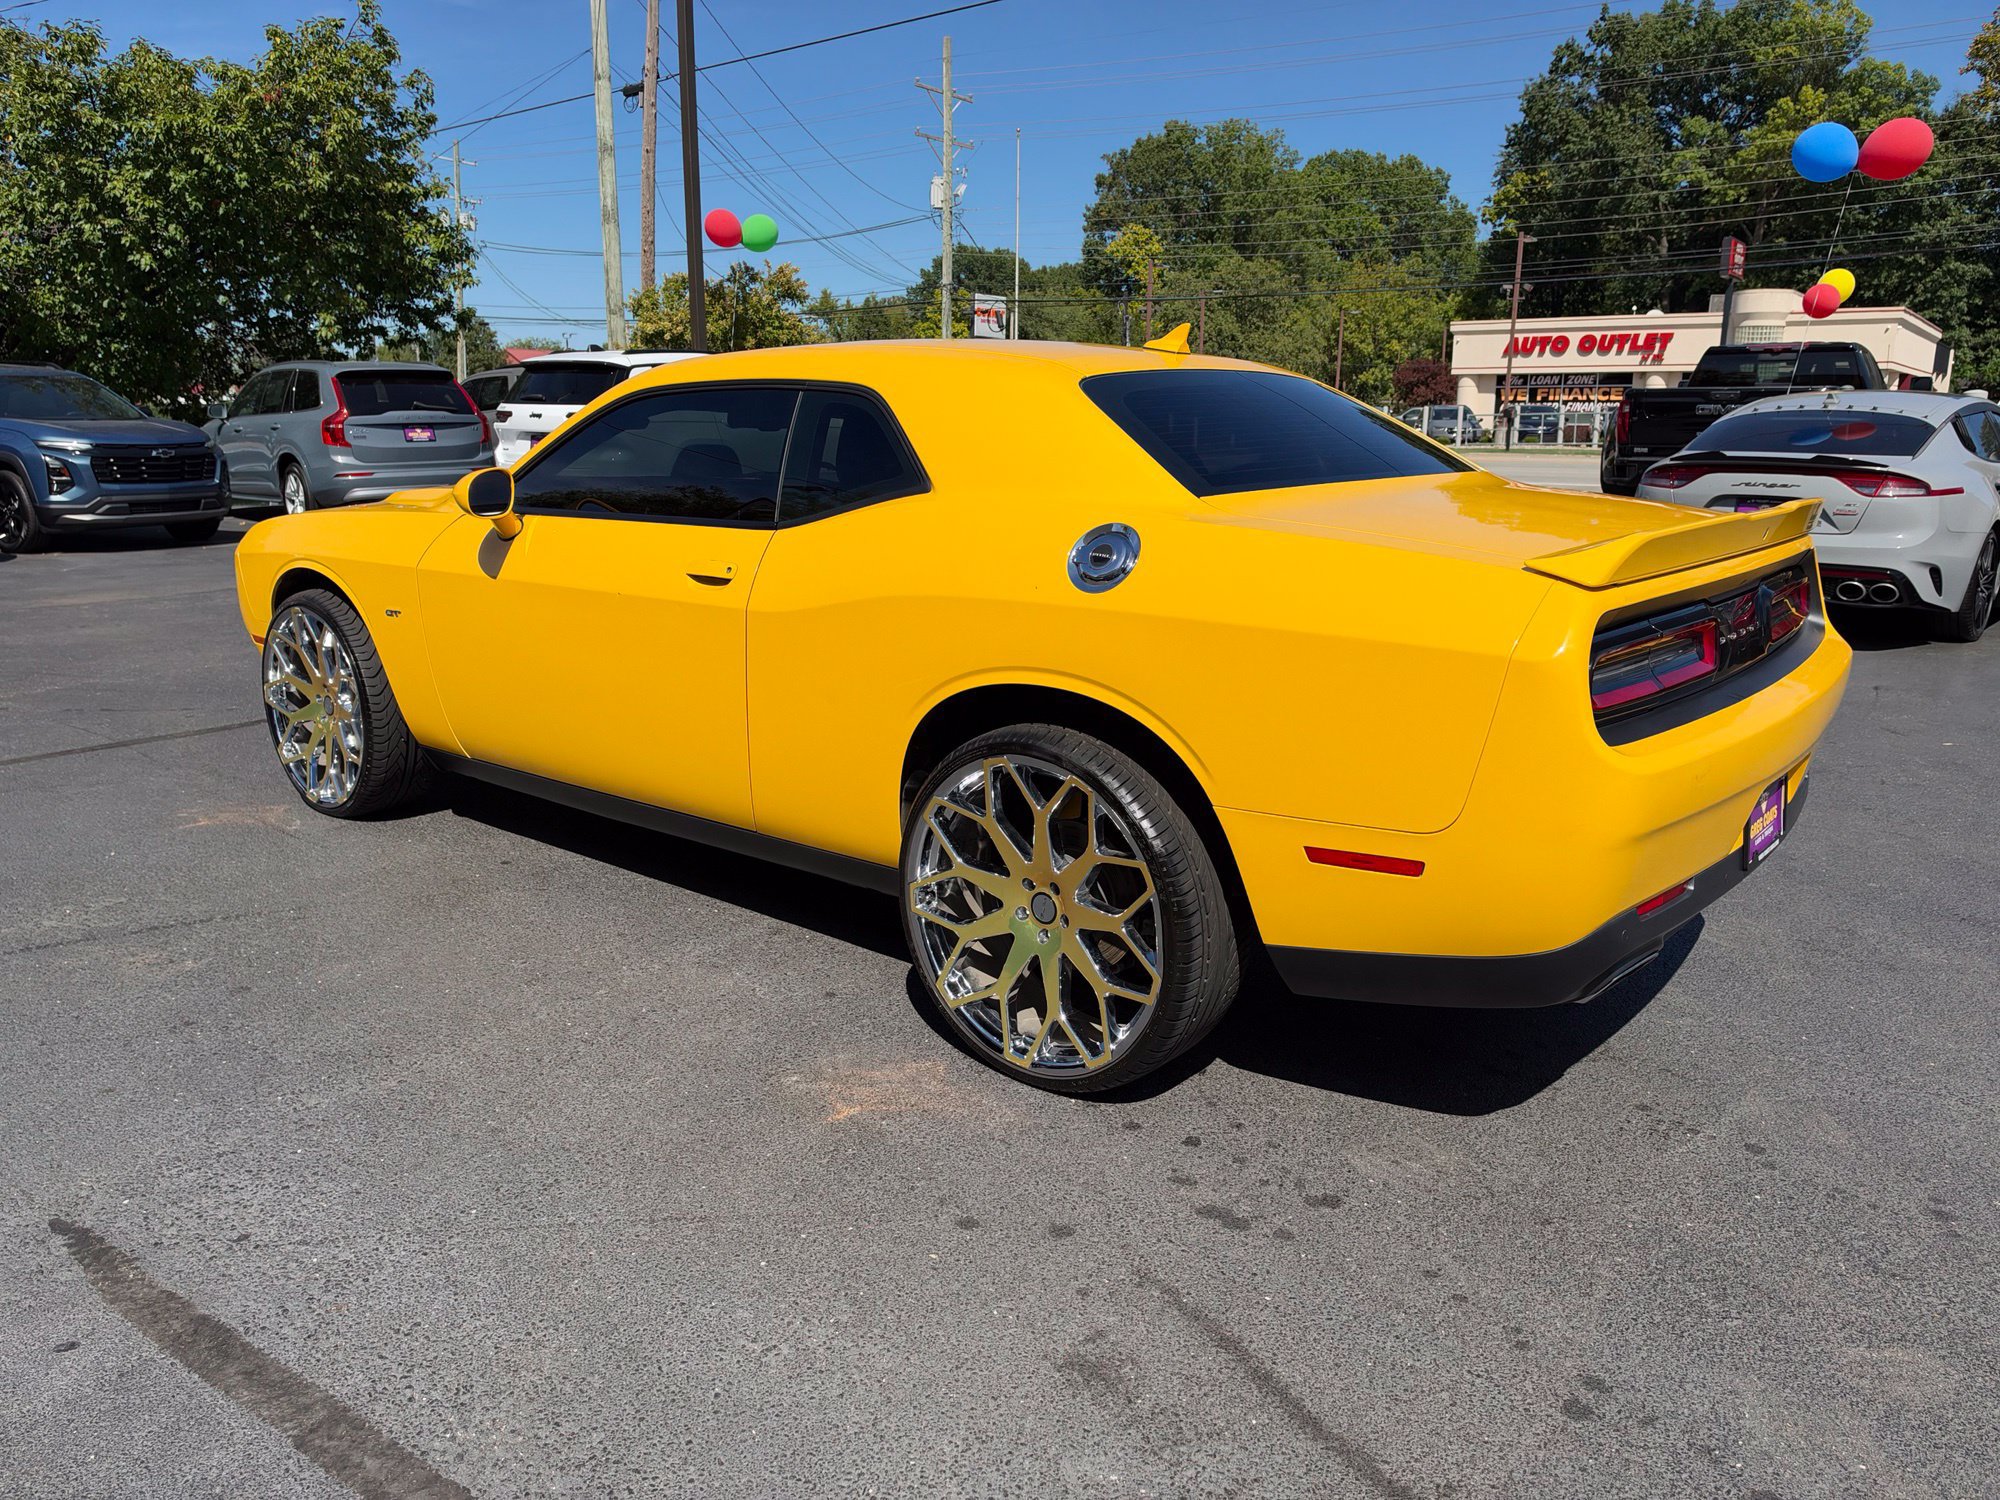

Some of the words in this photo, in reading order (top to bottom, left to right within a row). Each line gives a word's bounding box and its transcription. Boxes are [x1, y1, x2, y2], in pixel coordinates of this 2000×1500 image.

[1502, 335, 1570, 356] AUTO
[1577, 332, 1675, 355] OUTLET
[1530, 375, 1561, 385] LOAN
[1566, 374, 1596, 385] ZONE
[1500, 388, 1528, 401] WE
[1536, 387, 1624, 401] FINANCE
[1695, 404, 1745, 415] GM
[385, 609, 402, 618] GT
